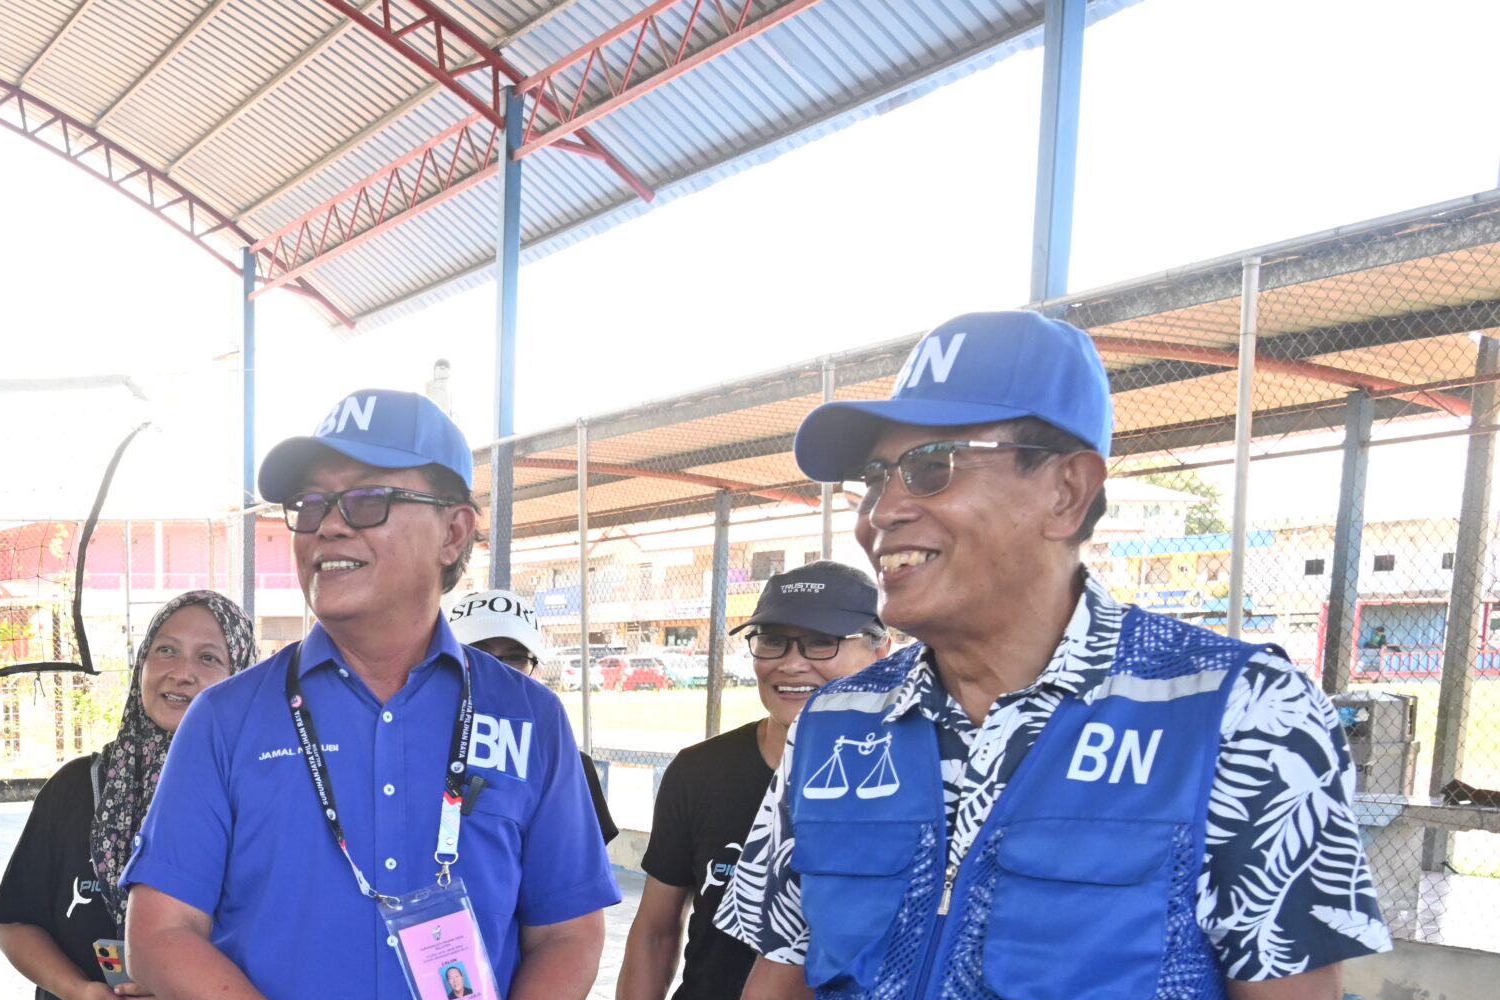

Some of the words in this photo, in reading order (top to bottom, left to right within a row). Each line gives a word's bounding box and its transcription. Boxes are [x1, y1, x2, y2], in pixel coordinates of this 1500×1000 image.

[780, 582, 825, 590] TRUSTED
[294, 710, 304, 727] RAYA
[461, 713, 472, 740] PILIHAN
[299, 727, 312, 755] PILIHAN
[458, 741, 468, 758] RAYA
[466, 713, 533, 780] BN
[259, 748, 295, 760] JAMAL
[1066, 722, 1164, 784] BN
